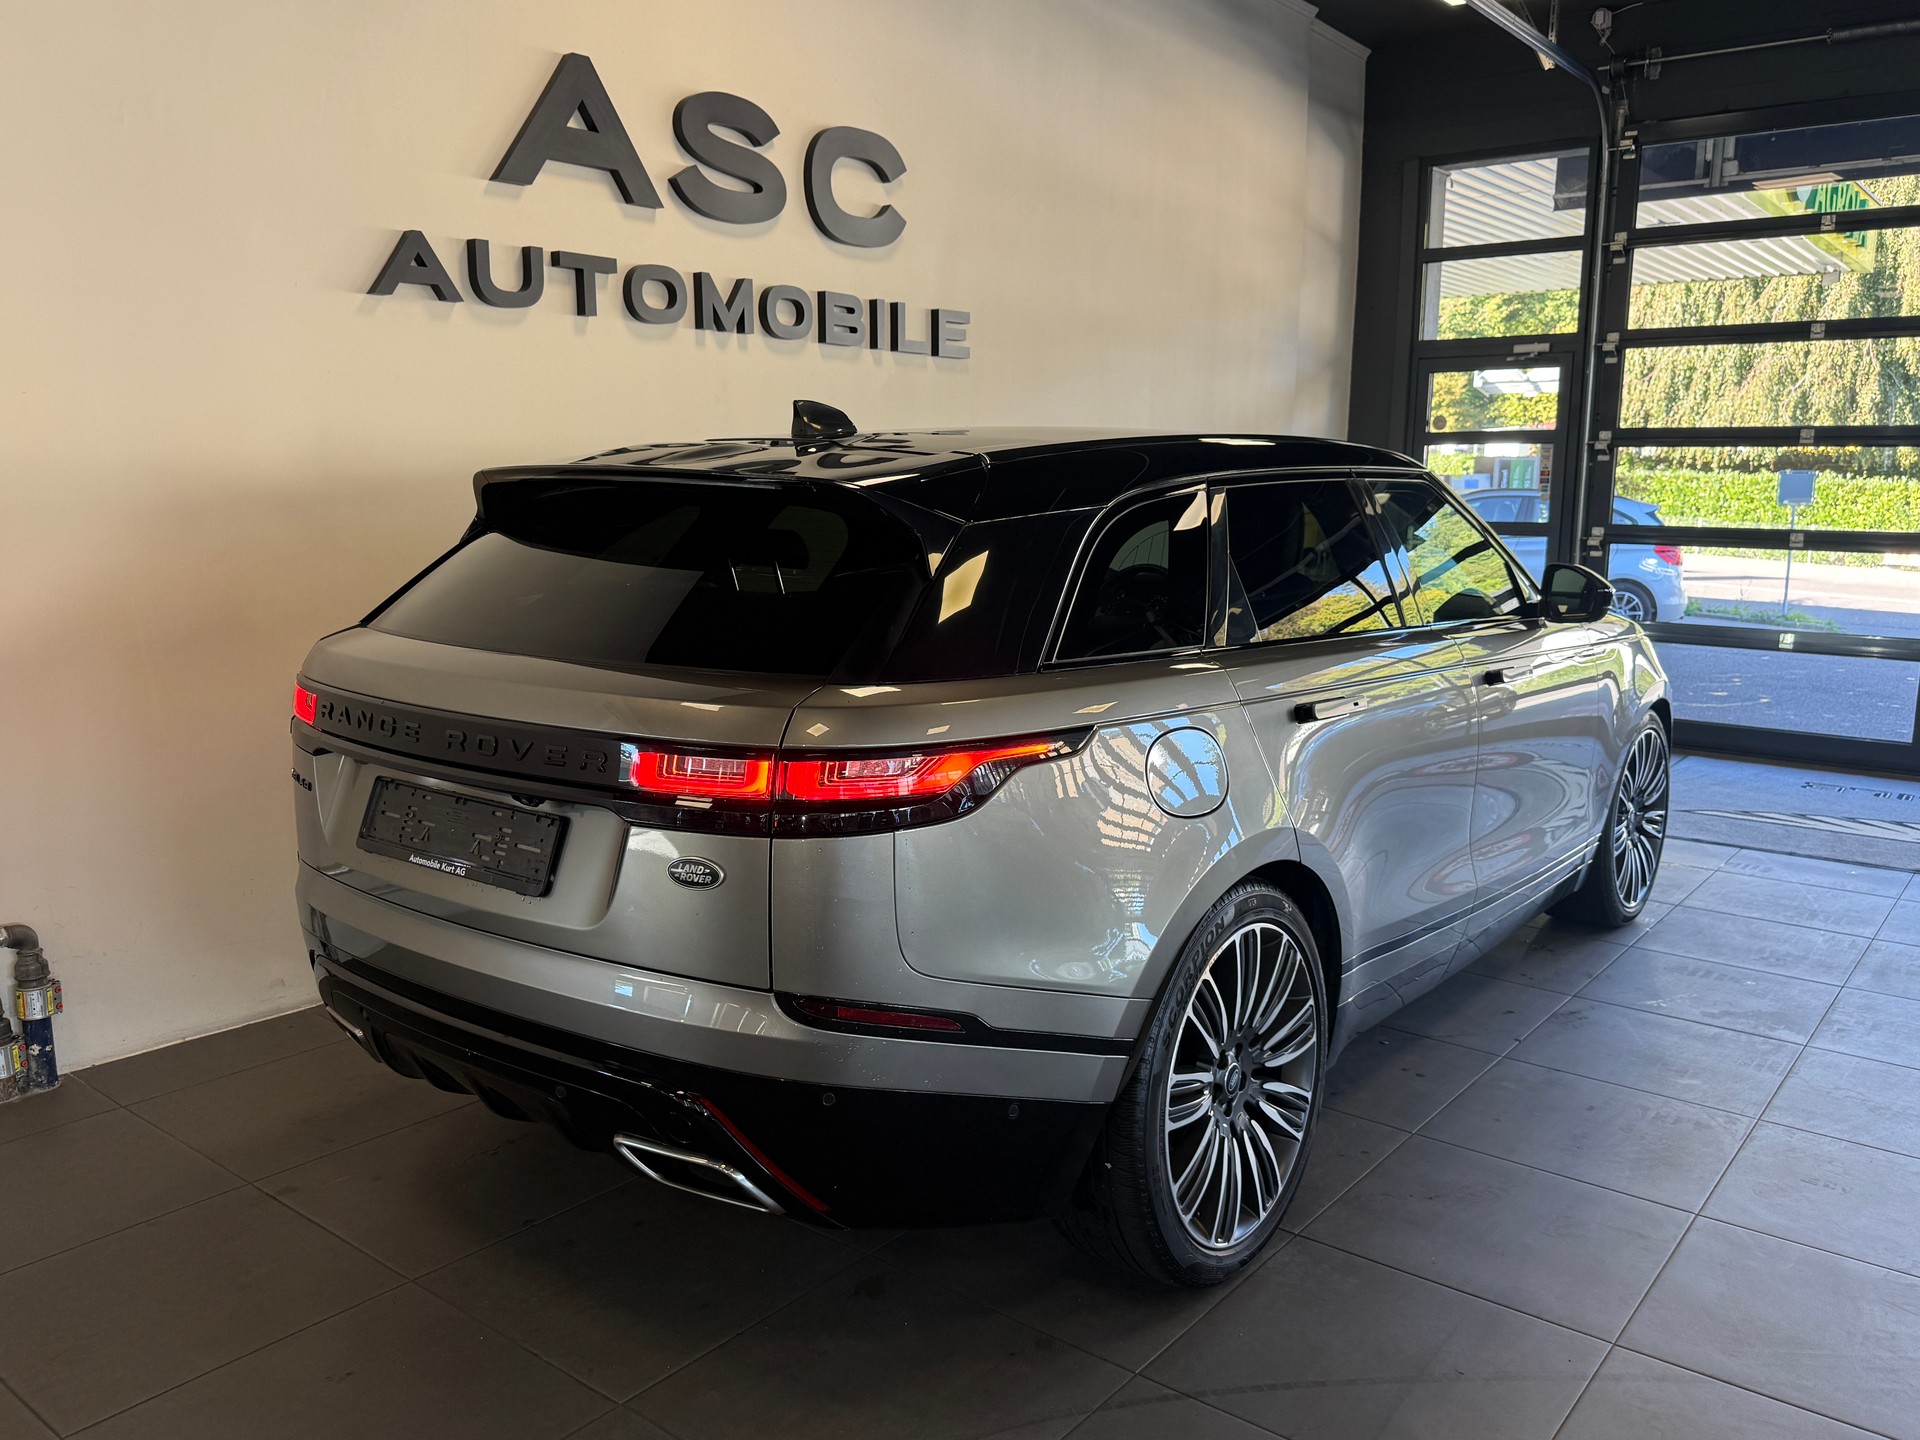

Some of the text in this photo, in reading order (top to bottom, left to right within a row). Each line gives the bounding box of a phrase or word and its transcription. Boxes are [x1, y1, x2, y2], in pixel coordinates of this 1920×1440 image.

[488, 52, 908, 248] ASC
[366, 229, 971, 359] AUTOMOBILE
[321, 701, 609, 773] RANGE ROVER
[408, 854, 467, 876] Automobile Kurt AG
[677, 863, 705, 874] LAND
[679, 872, 712, 884] ROVER
[1162, 915, 1226, 1048] SCORPION
